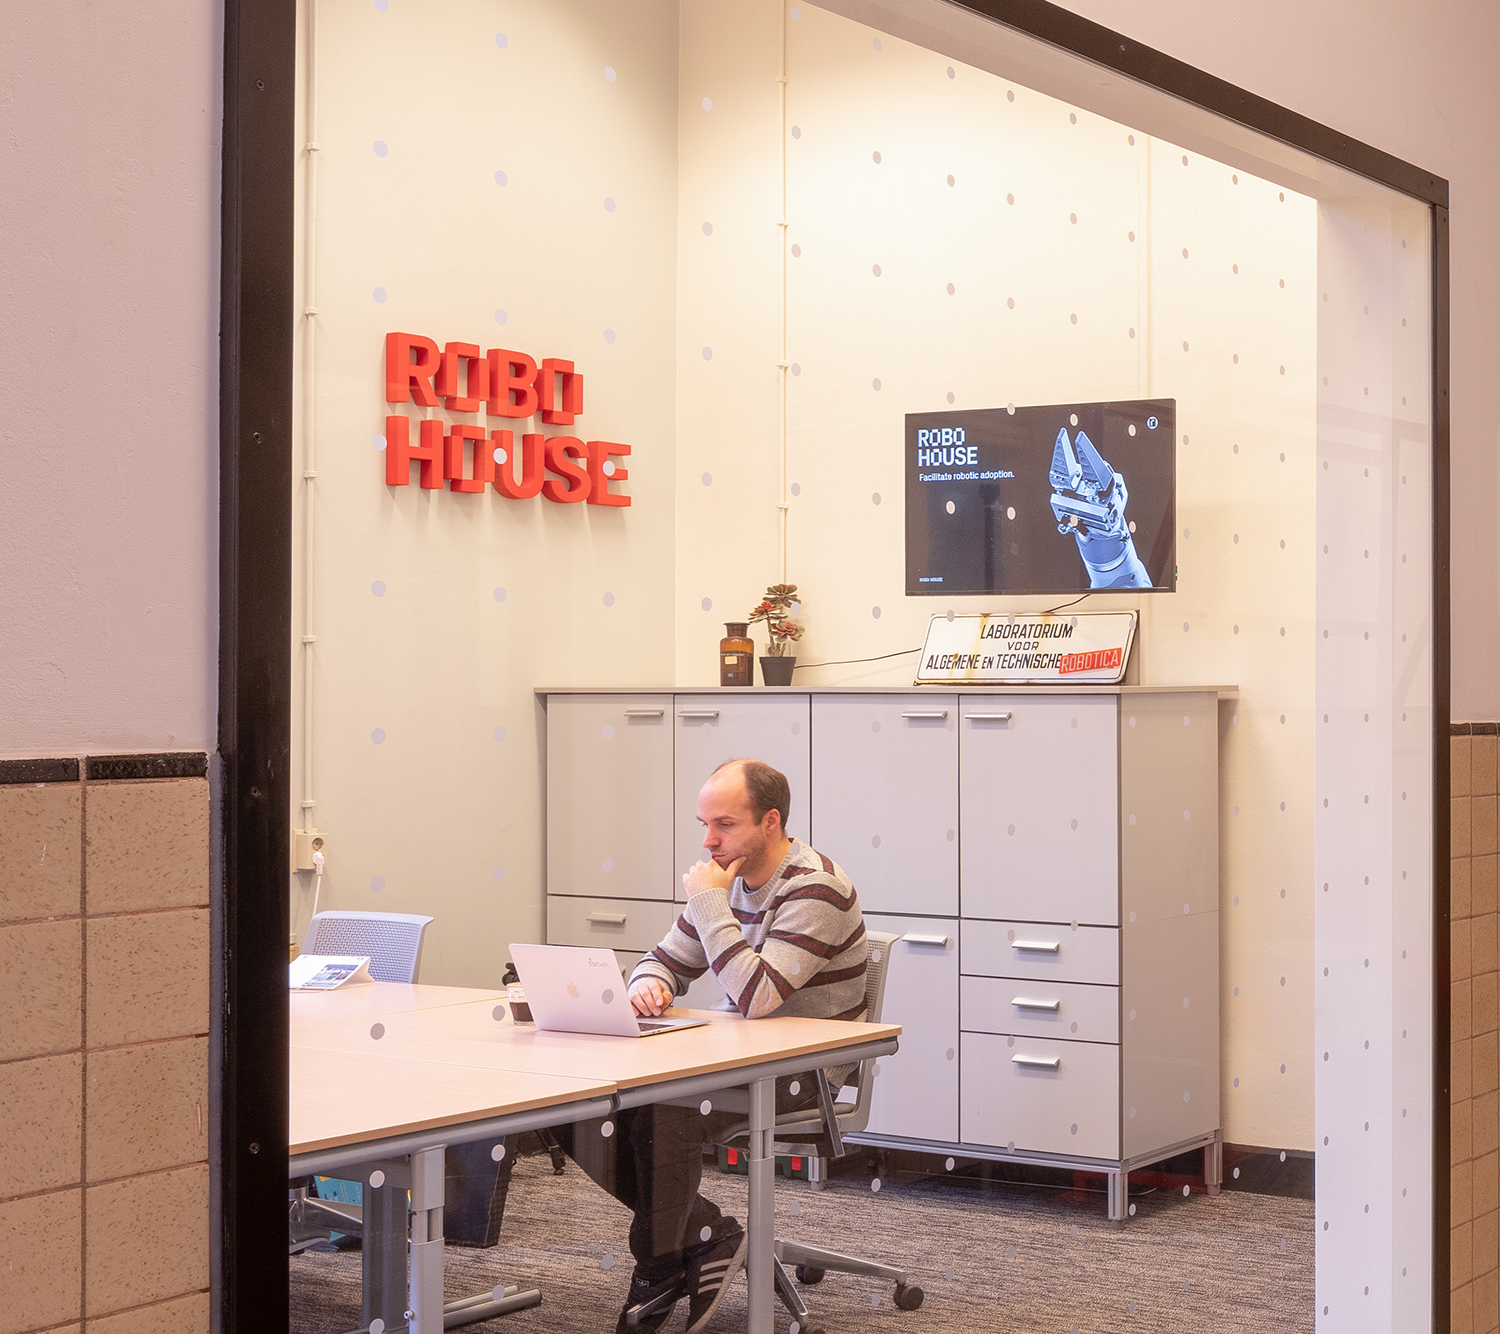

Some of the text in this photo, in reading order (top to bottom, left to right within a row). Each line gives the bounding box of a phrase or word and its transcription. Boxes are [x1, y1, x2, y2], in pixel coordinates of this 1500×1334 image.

[386, 332, 584, 425] ROBO
[918, 427, 966, 447] ROBO
[386, 415, 632, 507] HOUSE
[918, 446, 979, 467] HOUSE
[919, 470, 1015, 481] Facilitate robotic adoption.
[980, 623, 1074, 640] LABORATORIUM
[1007, 641, 1040, 651] VOOR
[926, 653, 981, 670] ALGEMENE
[996, 652, 1062, 669] TECHNISCHE
[1060, 649, 1119, 673] ROBOTICA
